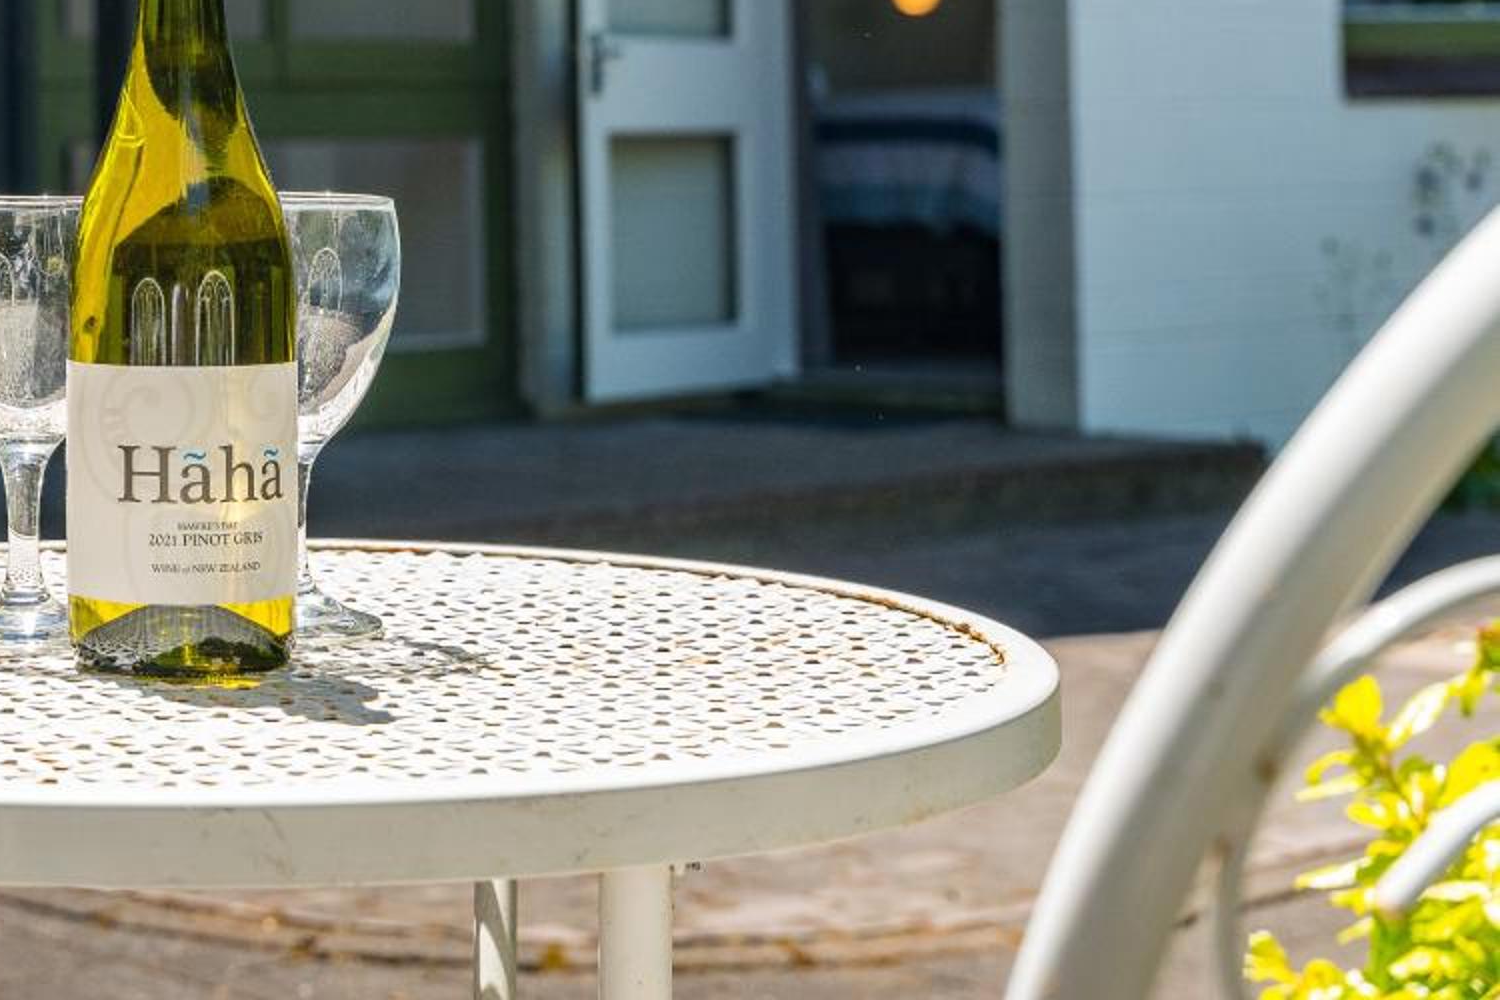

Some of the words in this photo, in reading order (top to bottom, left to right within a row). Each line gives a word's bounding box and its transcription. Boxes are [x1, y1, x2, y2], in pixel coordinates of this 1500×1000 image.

[148, 533, 177, 547] 2021
[182, 533, 231, 547] PINOT
[232, 531, 263, 546] GRIS
[191, 562, 216, 573] NEW
[219, 560, 261, 573] ZEALAND
